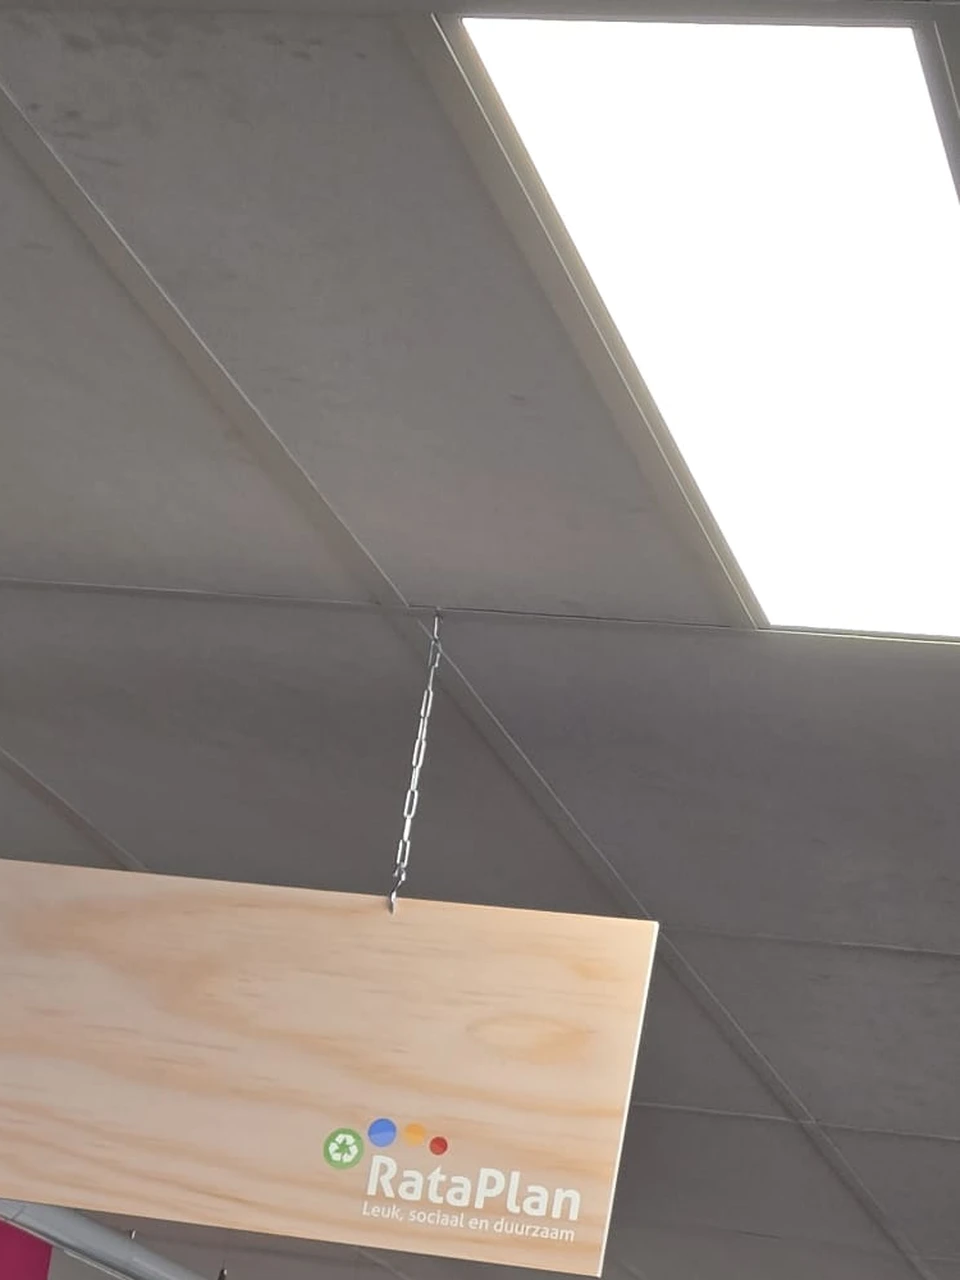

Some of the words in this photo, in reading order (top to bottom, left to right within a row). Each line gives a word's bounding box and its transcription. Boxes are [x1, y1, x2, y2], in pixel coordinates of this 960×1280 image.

[366, 1154, 582, 1221] RataPlan
[362, 1202, 404, 1221] Leuk,
[409, 1208, 464, 1229] sociaal
[468, 1217, 489, 1231] en
[493, 1217, 576, 1243] duurzaam
